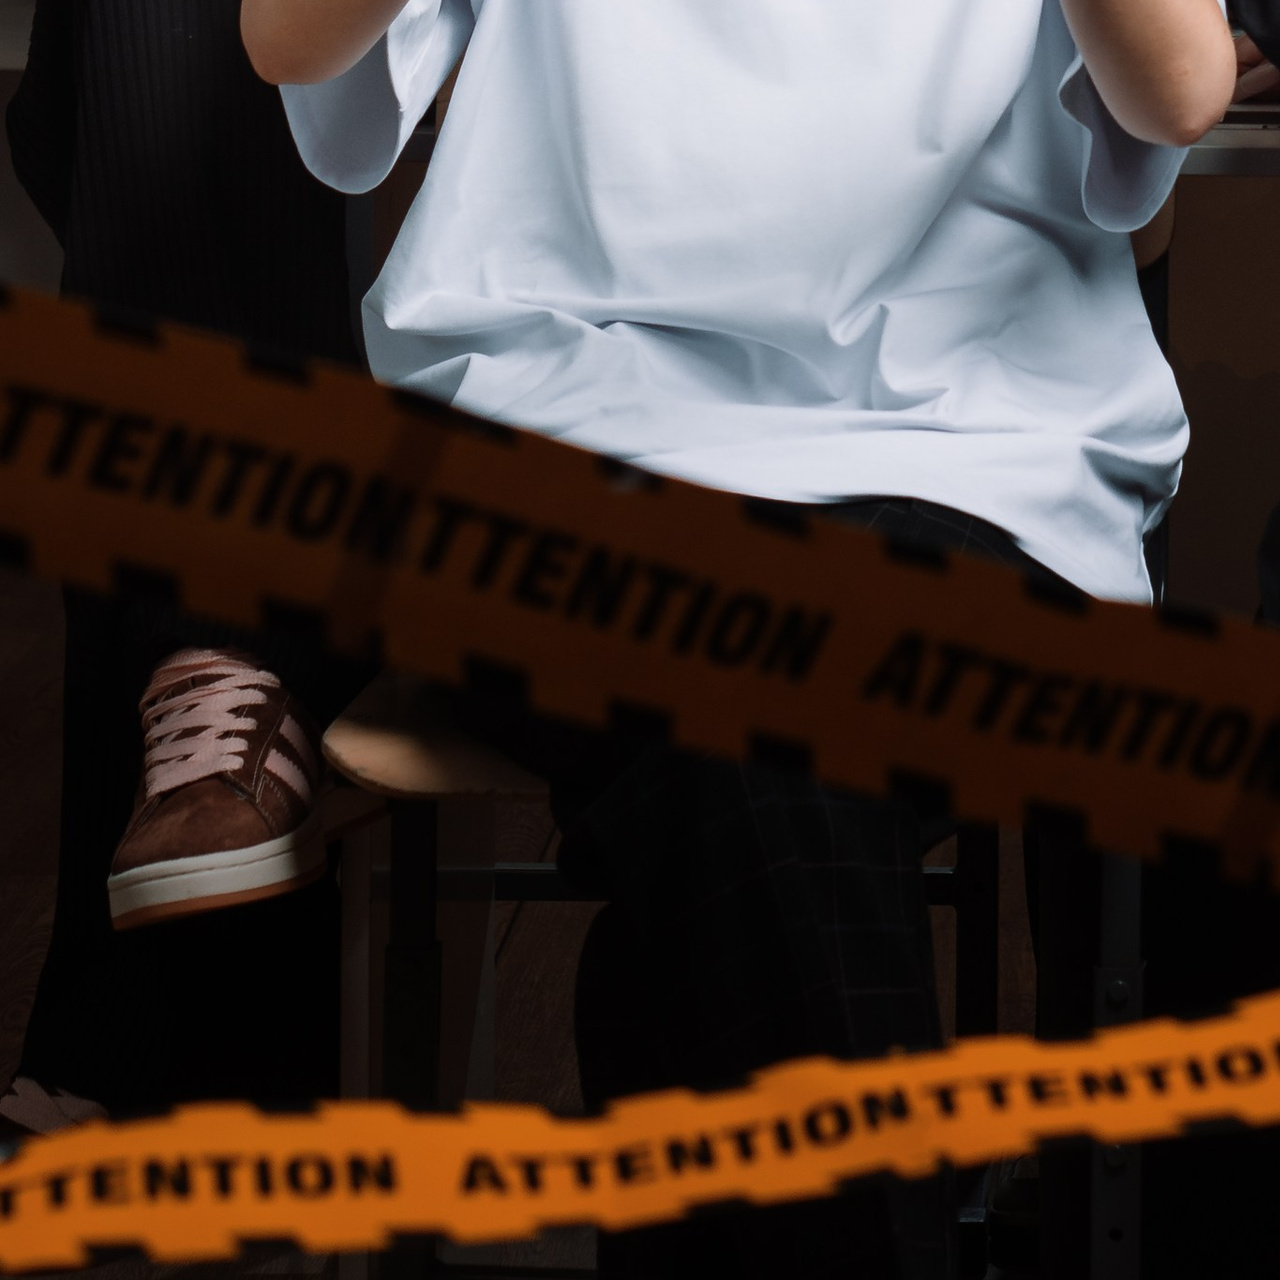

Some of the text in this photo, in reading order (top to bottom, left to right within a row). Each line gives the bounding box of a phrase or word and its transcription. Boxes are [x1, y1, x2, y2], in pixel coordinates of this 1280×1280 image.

[0, 385, 417, 564] TTENTION
[0, 1152, 396, 1218] TTENTION
[461, 1087, 909, 1195] ATTENTION
